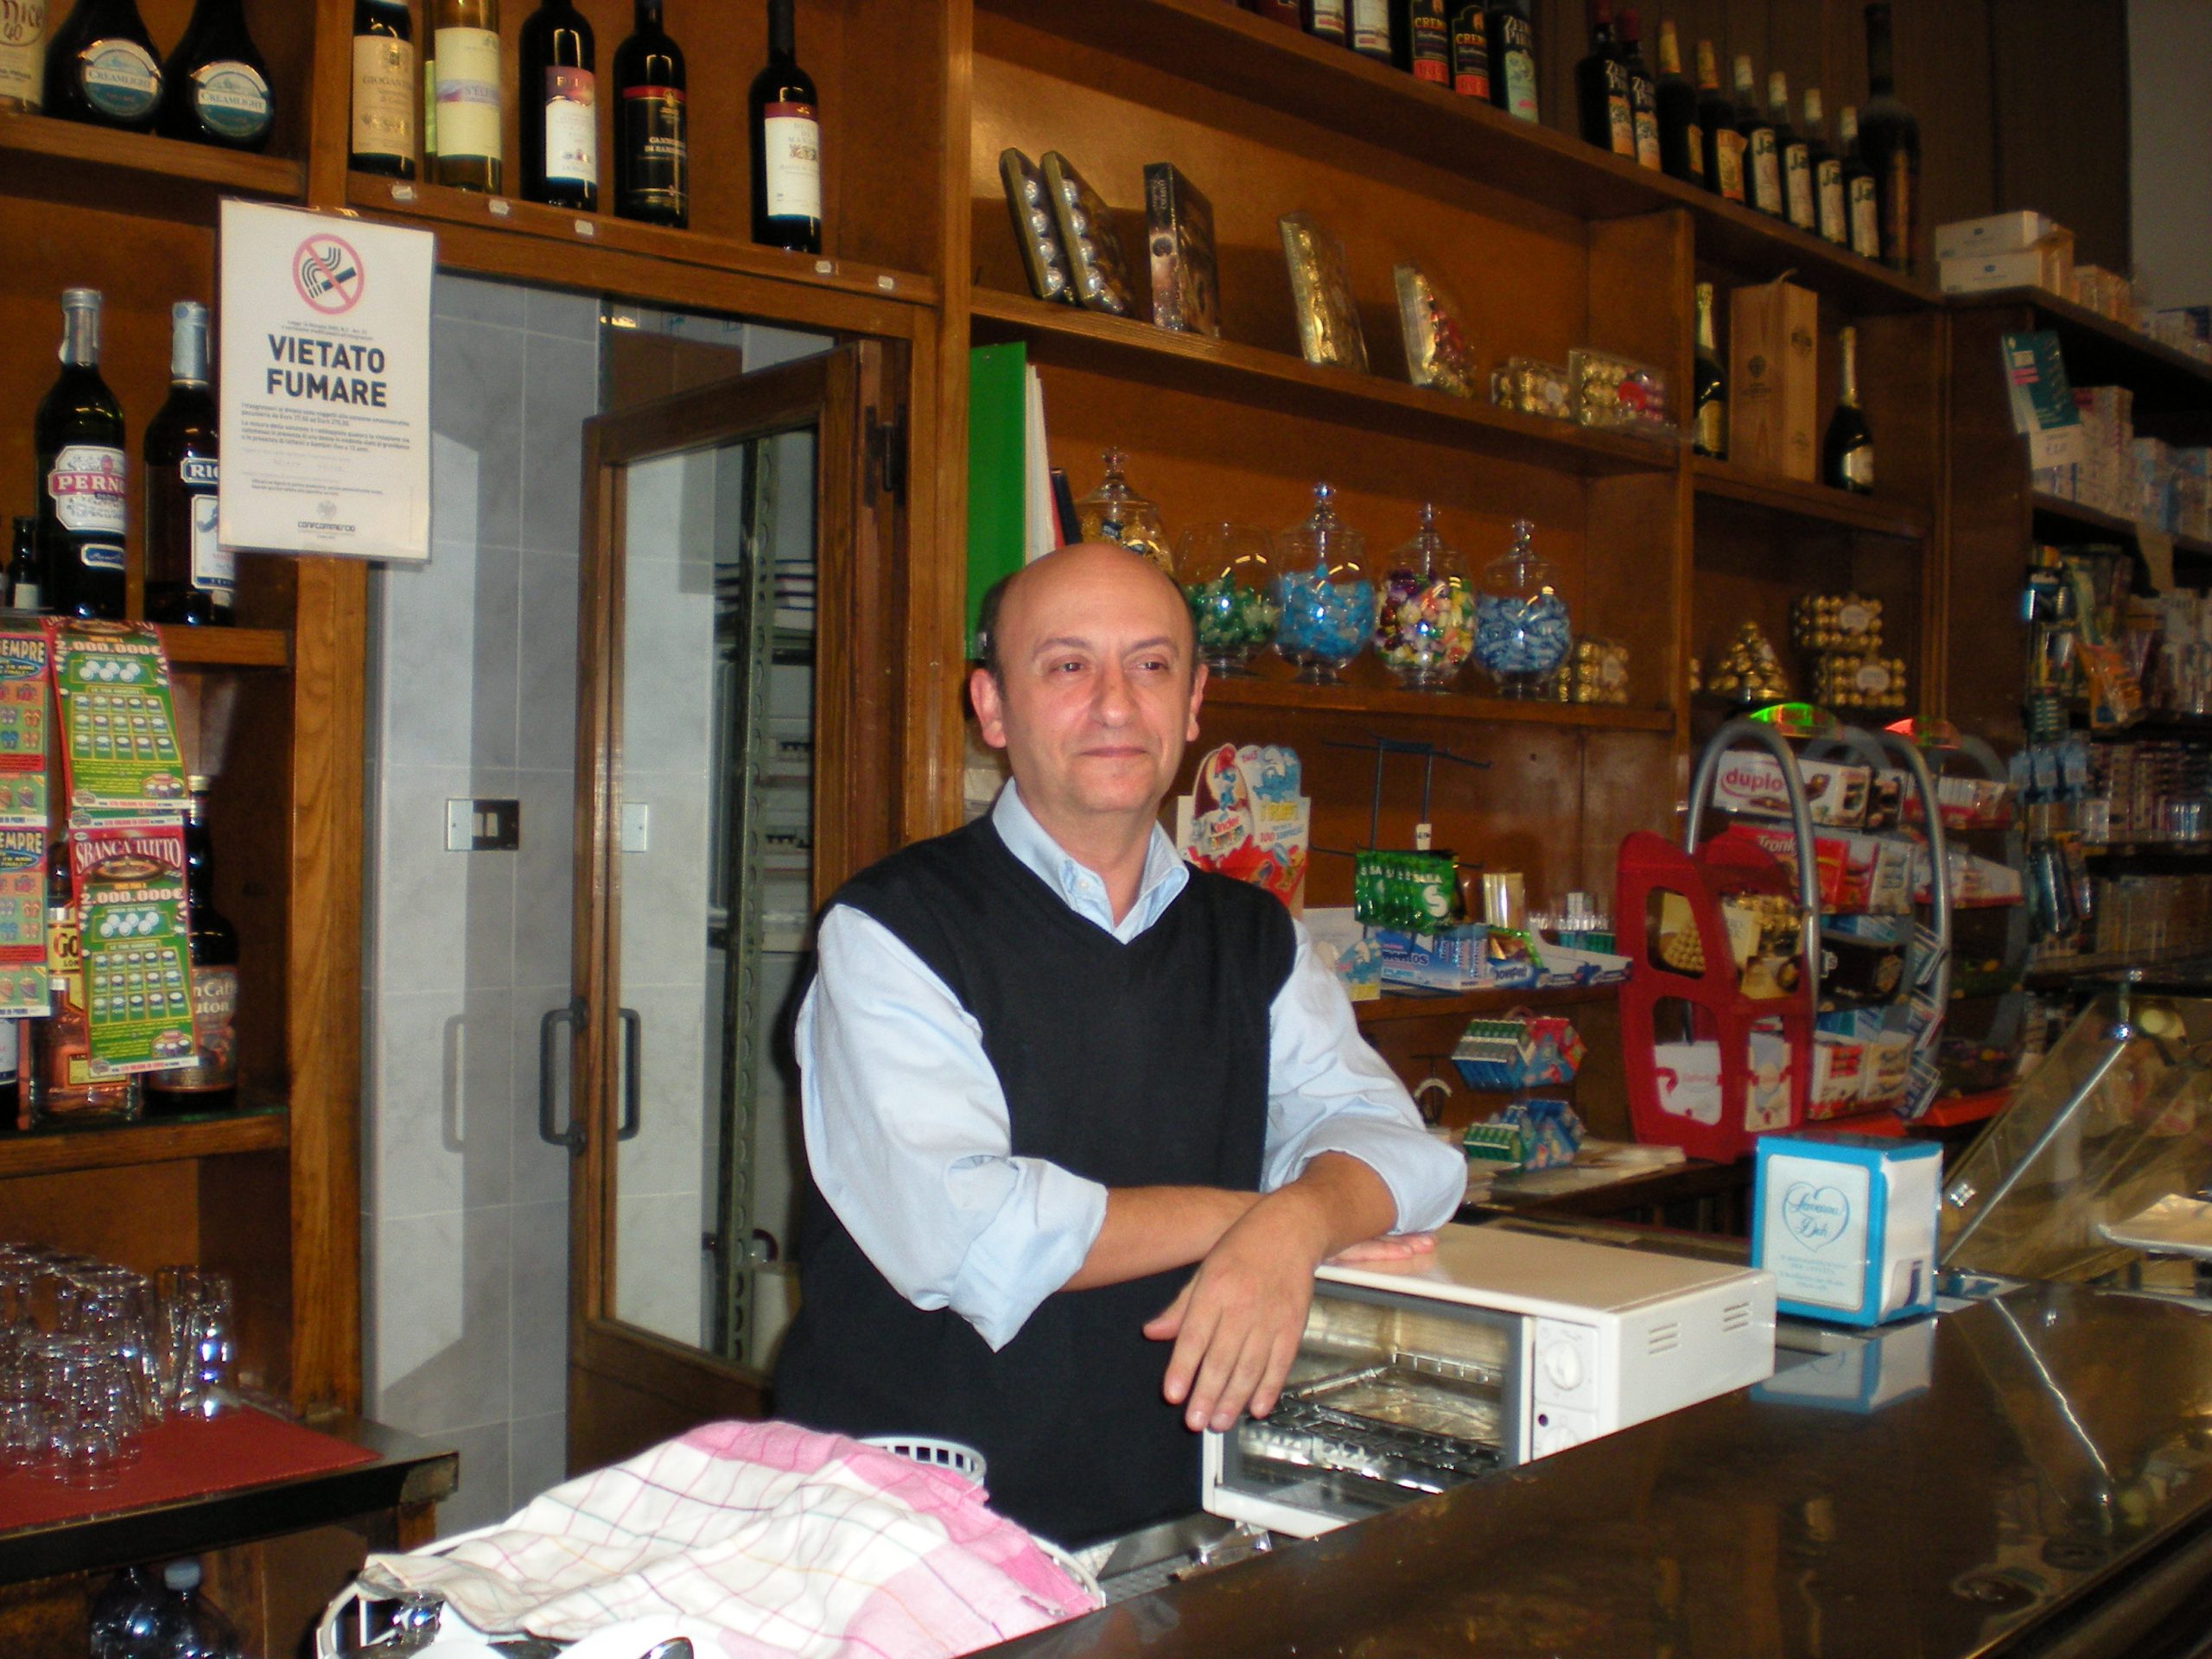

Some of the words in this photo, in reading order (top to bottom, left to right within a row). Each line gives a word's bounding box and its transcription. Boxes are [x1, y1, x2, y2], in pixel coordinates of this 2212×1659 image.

[268, 334, 385, 373] VIETATO
[267, 368, 387, 407] FUMARE
[57, 474, 124, 493] PERN
[1726, 768, 1784, 792] duplo
[1758, 834, 1797, 857] Tronk
